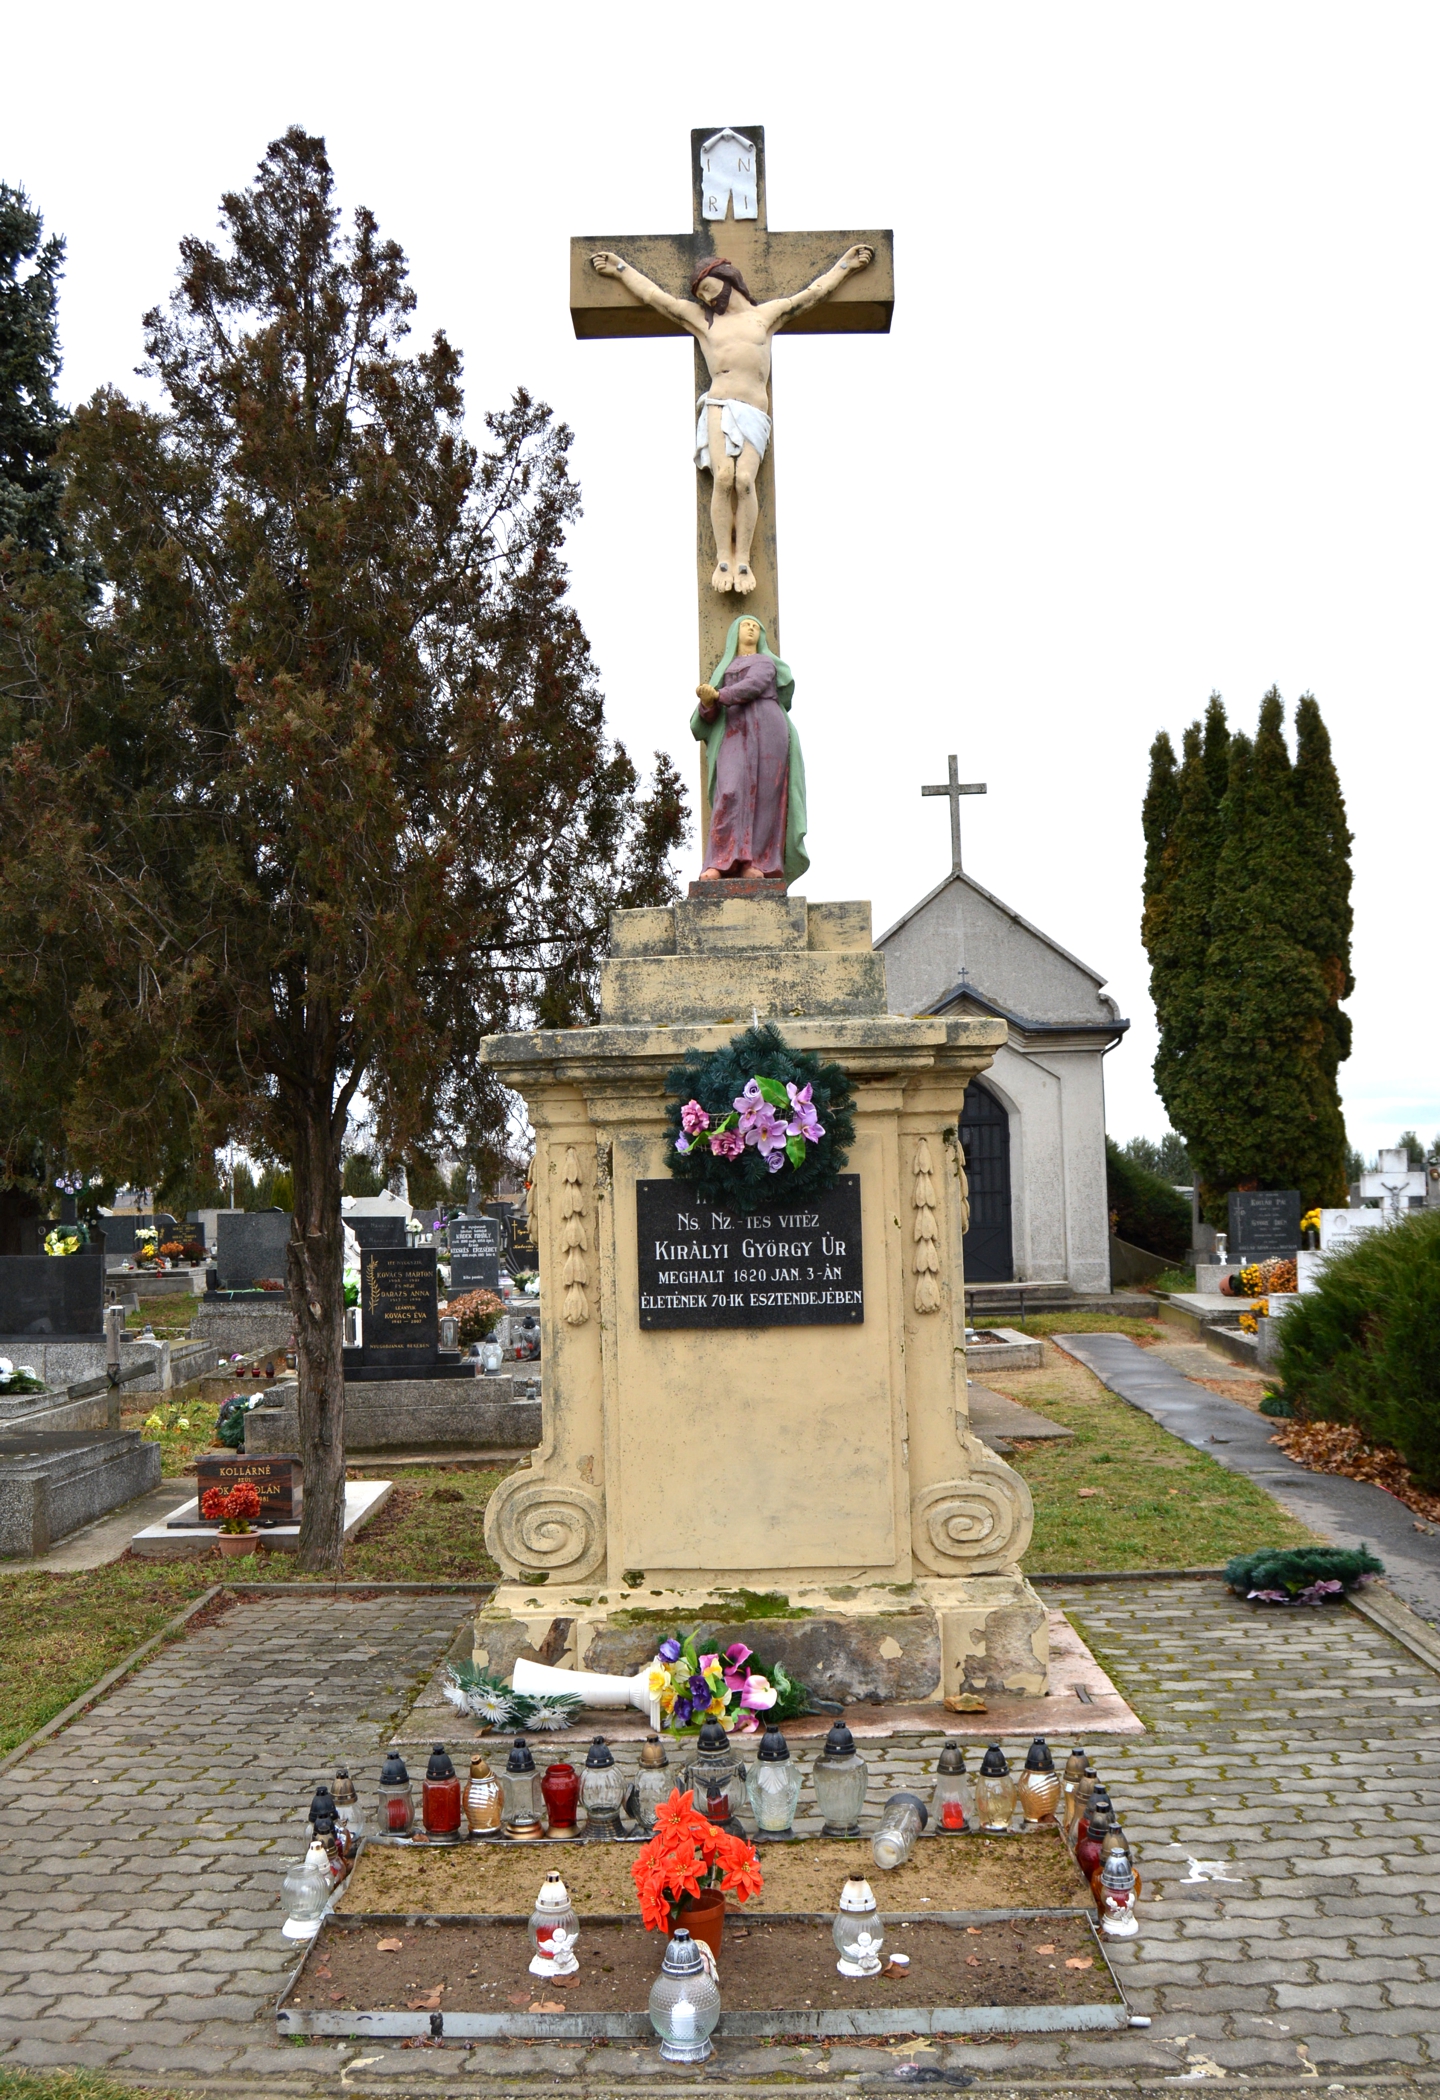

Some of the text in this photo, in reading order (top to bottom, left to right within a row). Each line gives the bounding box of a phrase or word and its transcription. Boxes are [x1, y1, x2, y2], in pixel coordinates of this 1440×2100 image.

[778, 1210, 820, 1228] VITÉZ
[655, 1231, 847, 1260] KIRÁLYI GYÖRGY ÚR
[658, 1263, 842, 1284] MEGHALT 1820 JAN. 3-ÁN
[641, 1287, 863, 1309] ÉLETÉNEK 70-IK ESZTENDEJÉBEN
[413, 1311, 427, 1319] ÉVA
[220, 1464, 271, 1476] KOLLÁRNÉ
